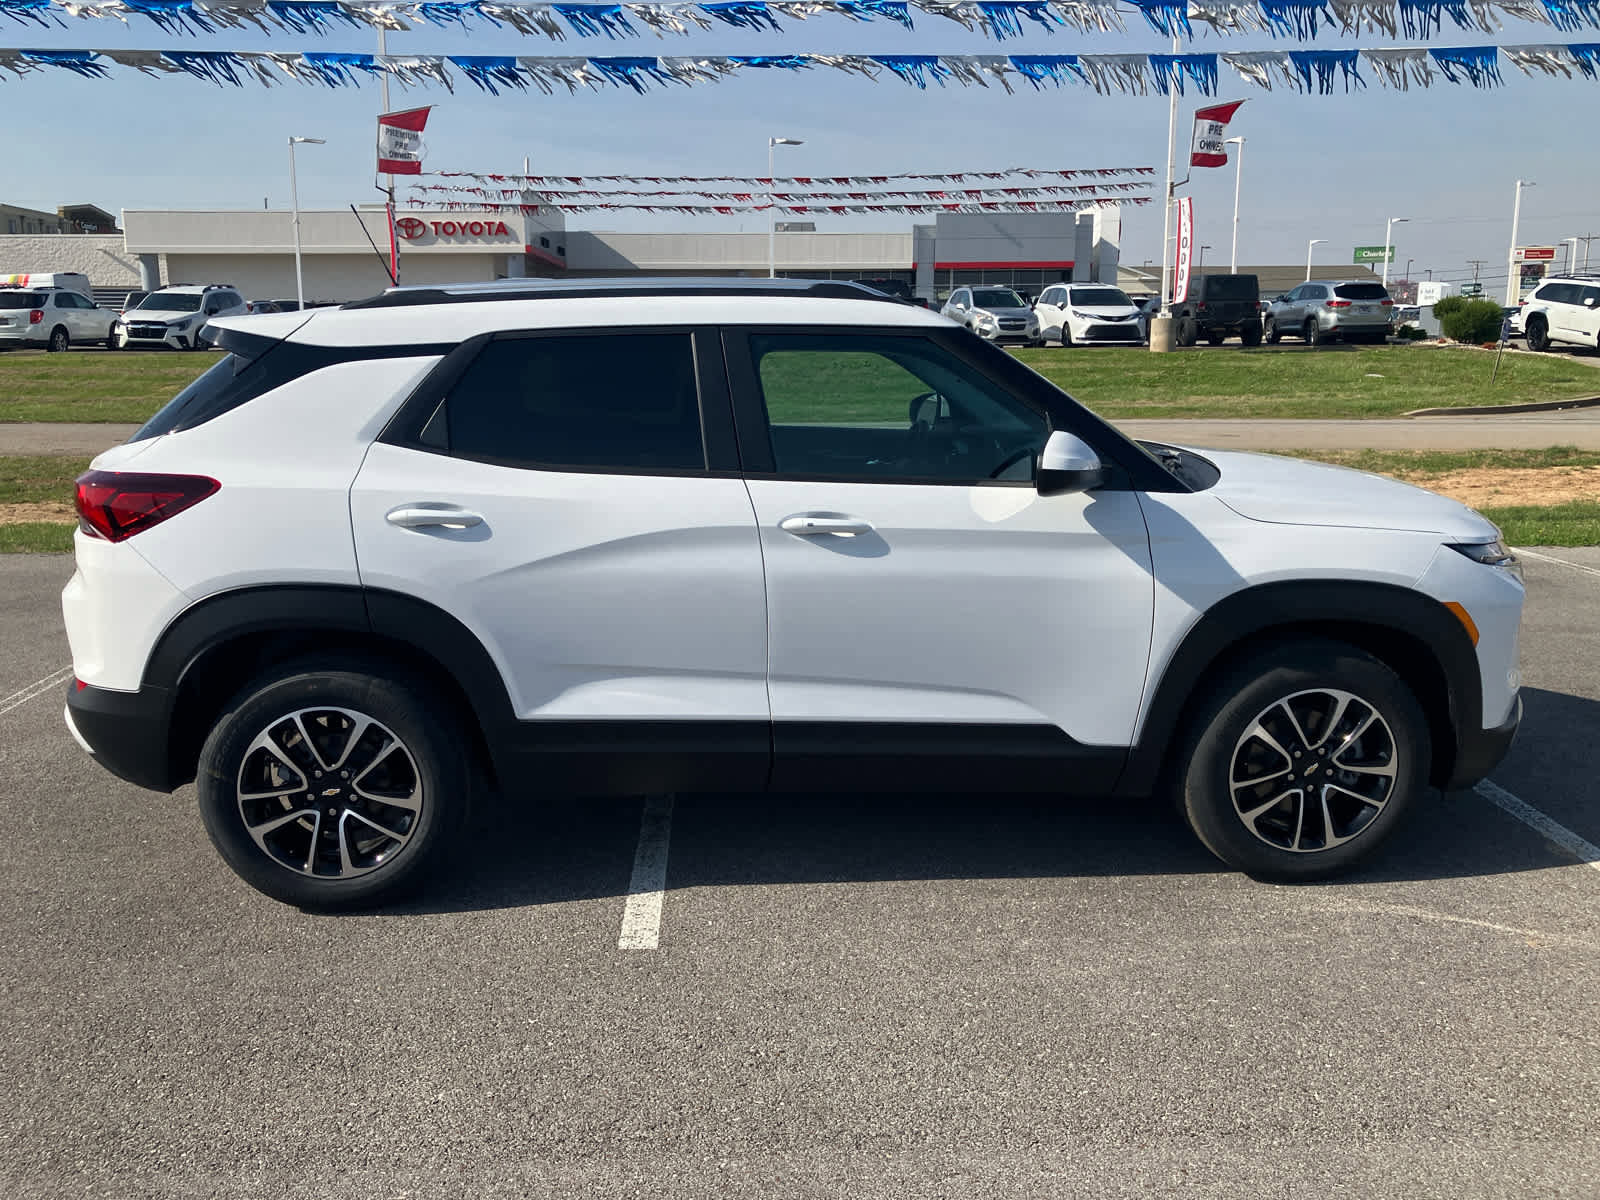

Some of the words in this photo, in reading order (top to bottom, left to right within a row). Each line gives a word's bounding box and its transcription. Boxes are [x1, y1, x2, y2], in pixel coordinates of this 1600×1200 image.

[385, 127, 418, 141] PREMIUM
[1208, 124, 1223, 136] PRE
[394, 141, 409, 151] PRE
[430, 221, 508, 236] TOYOTA
